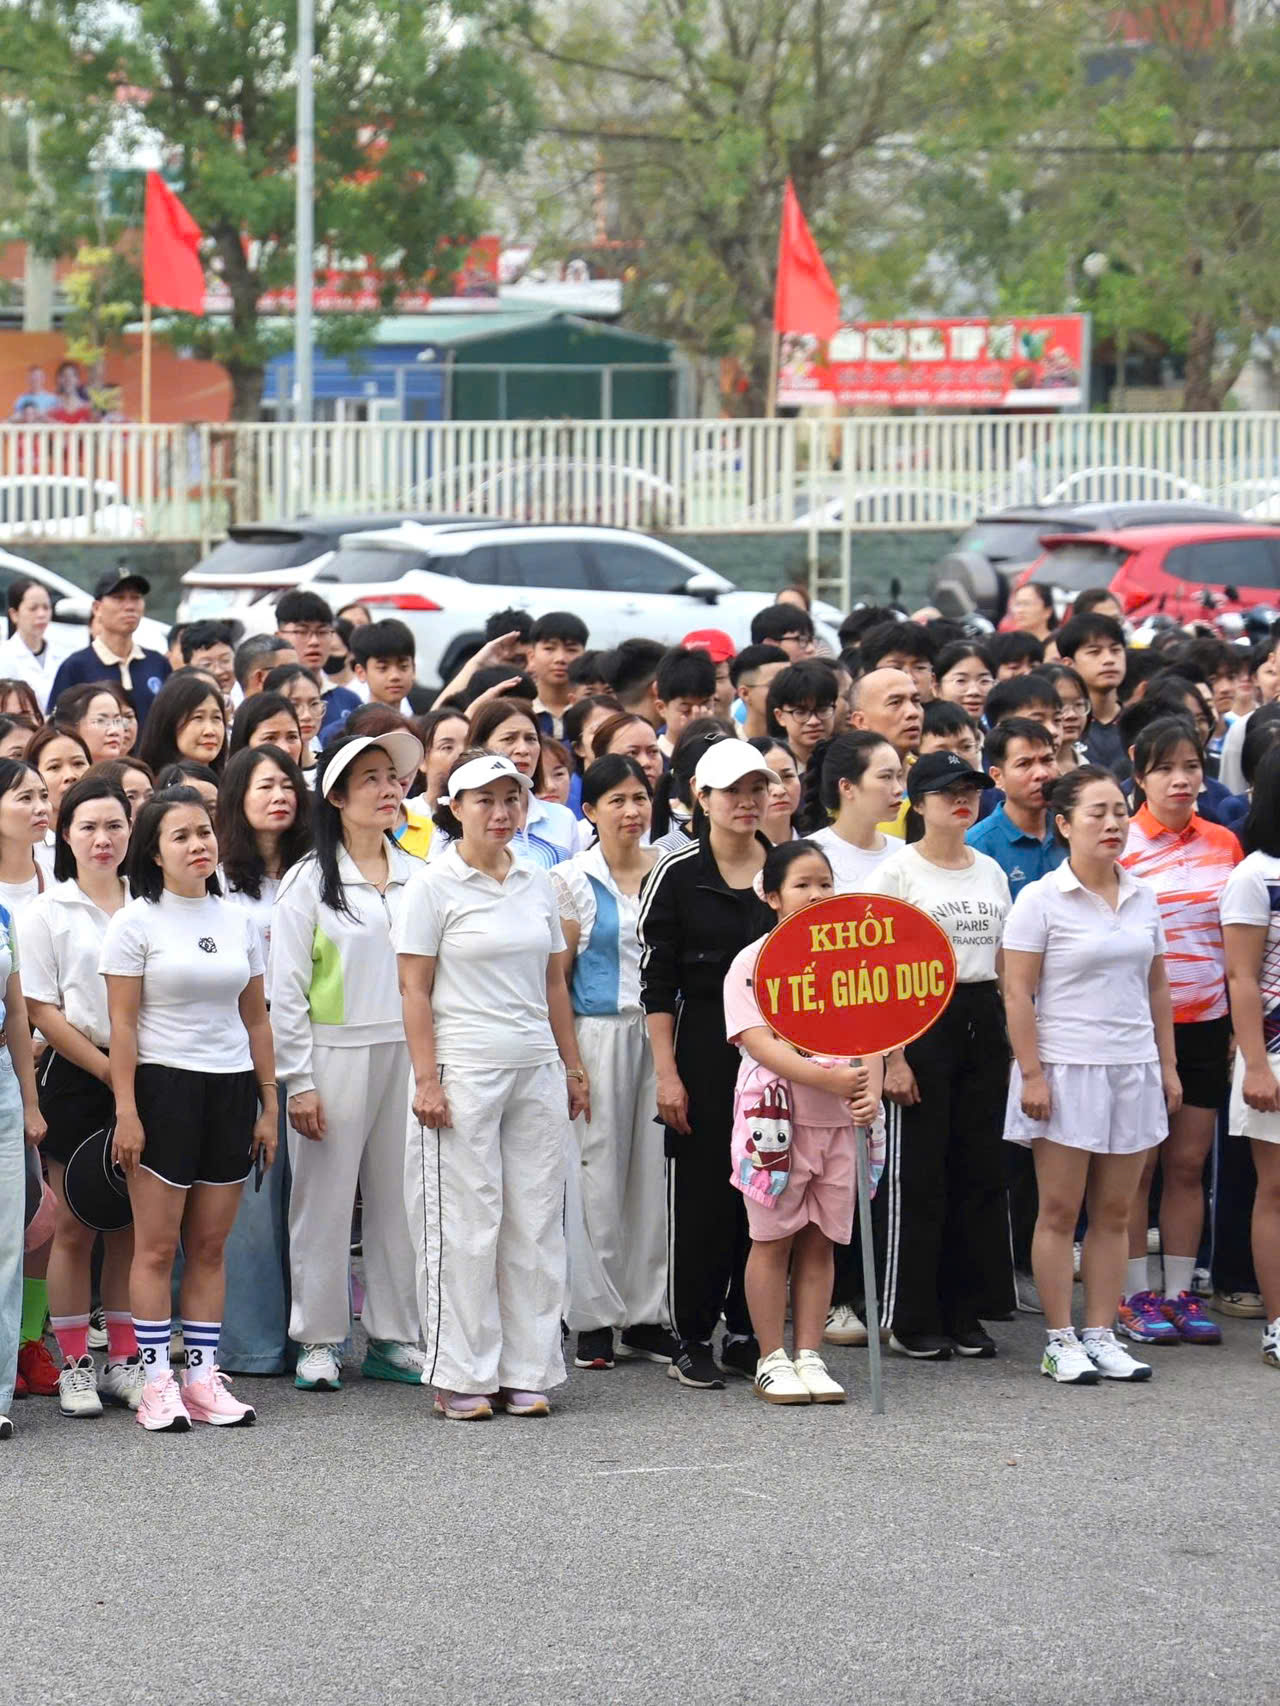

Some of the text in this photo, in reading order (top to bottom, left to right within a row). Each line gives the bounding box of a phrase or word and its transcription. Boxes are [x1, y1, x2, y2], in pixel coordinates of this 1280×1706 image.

[808, 904, 896, 953] KHỐI
[956, 920, 989, 931] PARIS
[952, 936, 994, 946] FRANÇOIS
[766, 959, 945, 1015] Y TẾ, GIÁO DỤC
